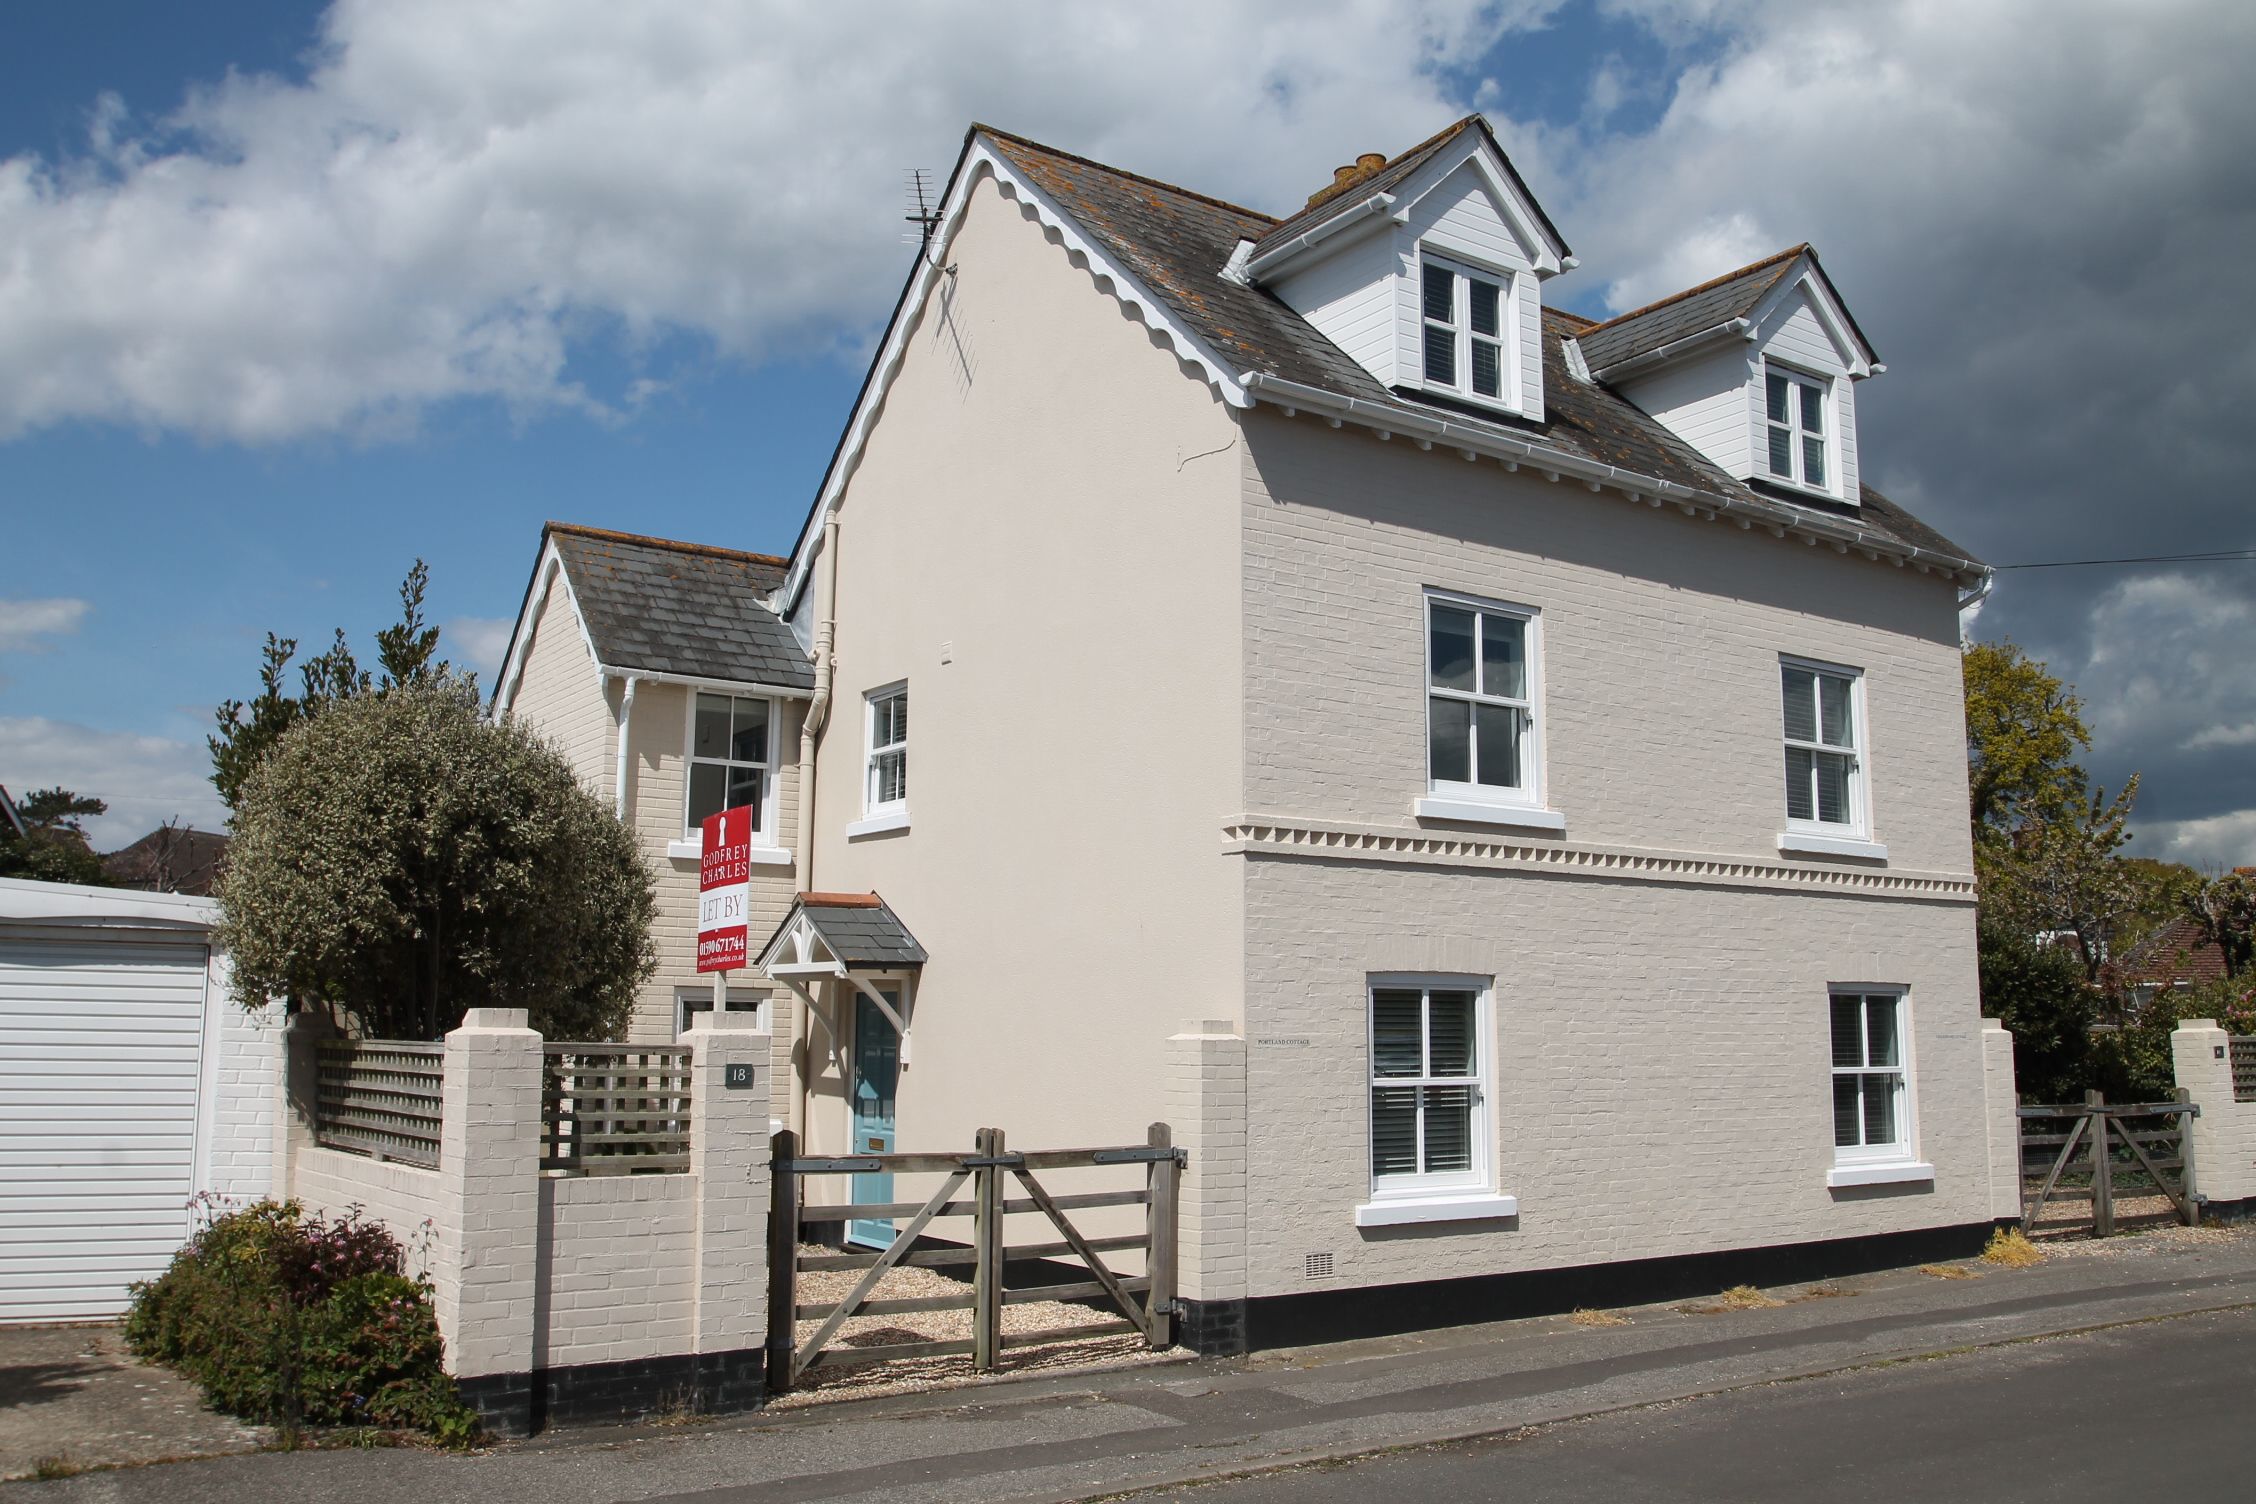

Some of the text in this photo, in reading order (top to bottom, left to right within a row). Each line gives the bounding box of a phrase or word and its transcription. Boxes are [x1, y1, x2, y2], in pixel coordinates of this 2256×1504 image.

[703, 844, 748, 868] GODFREY
[702, 861, 747, 885] CHARLES
[703, 894, 744, 922] LET BY
[733, 1068, 746, 1081] 18
